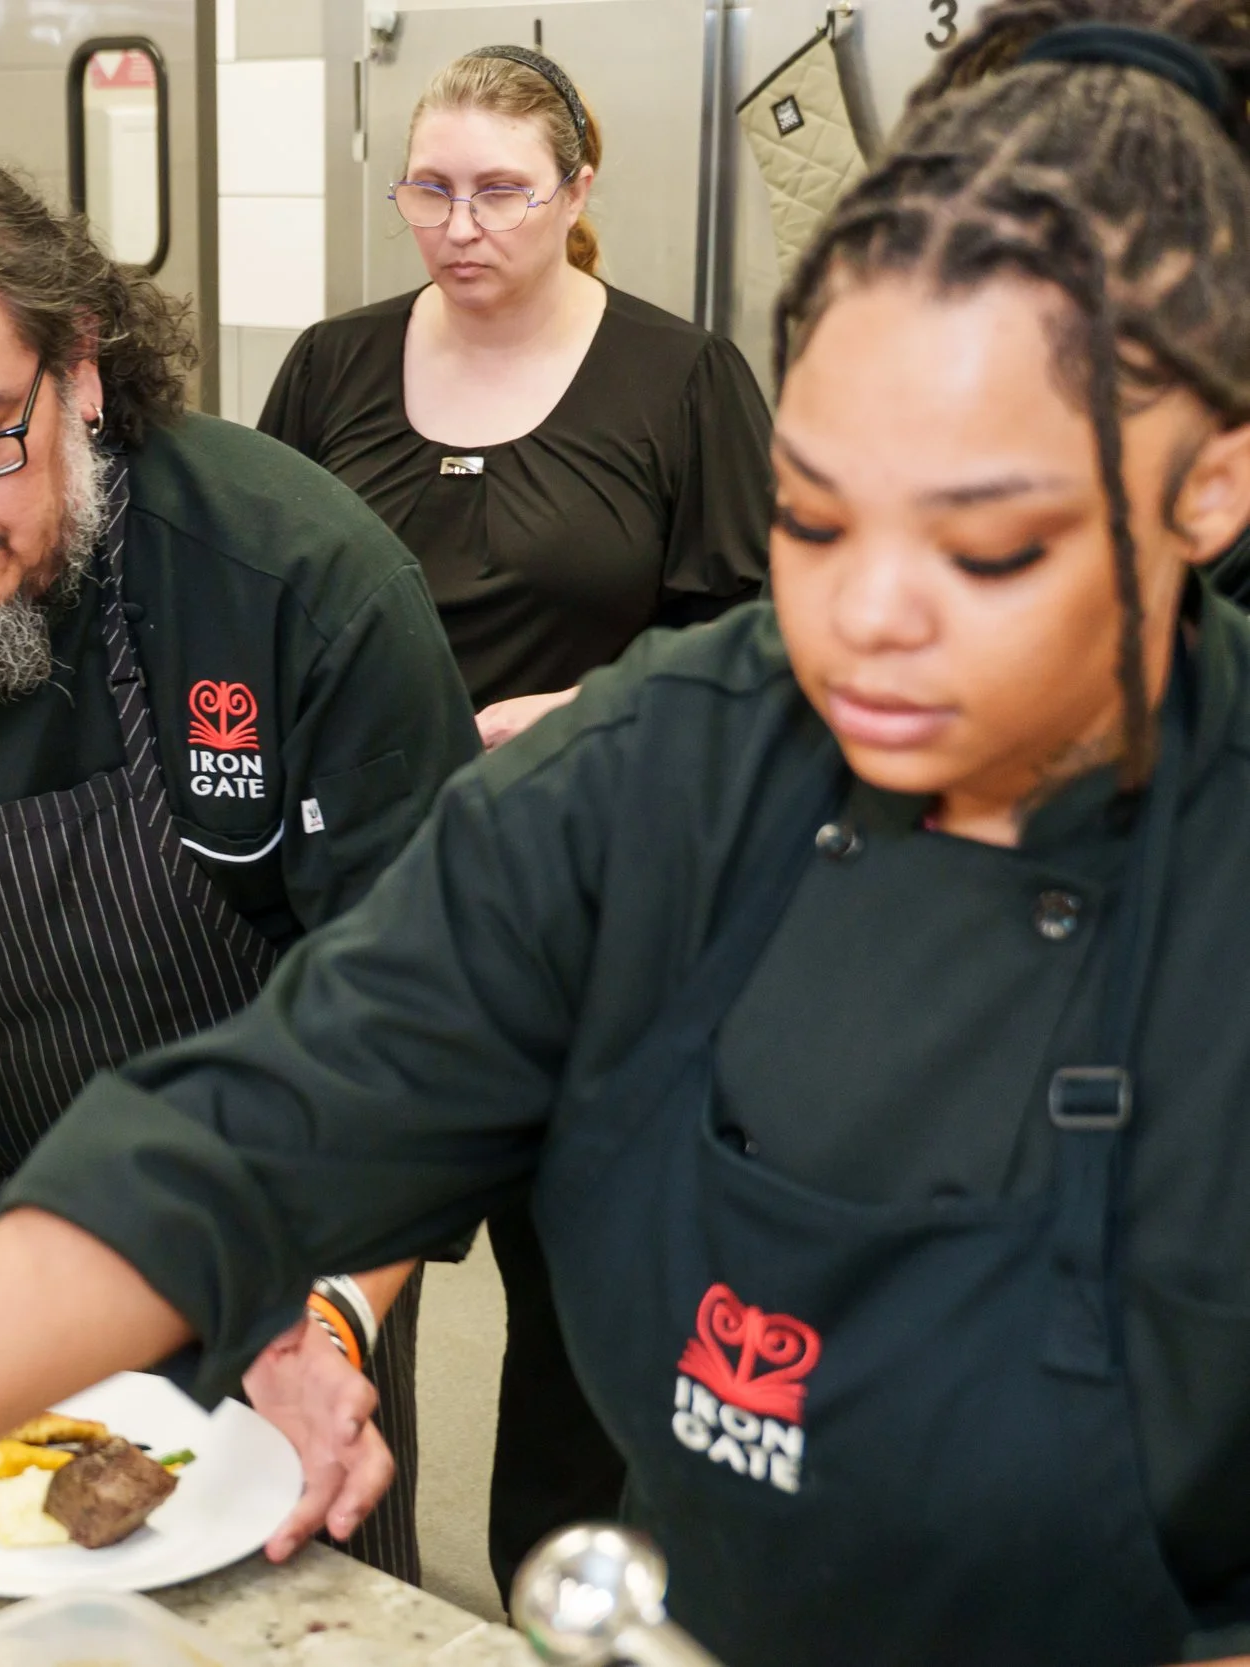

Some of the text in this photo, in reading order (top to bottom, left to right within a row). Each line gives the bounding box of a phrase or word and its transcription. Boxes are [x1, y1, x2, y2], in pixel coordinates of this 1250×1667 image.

[925, 0, 958, 51] 3
[189, 750, 263, 776] IRON
[190, 775, 266, 799] GATE
[674, 1376, 805, 1459] IRON
[672, 1411, 800, 1494] GATE
